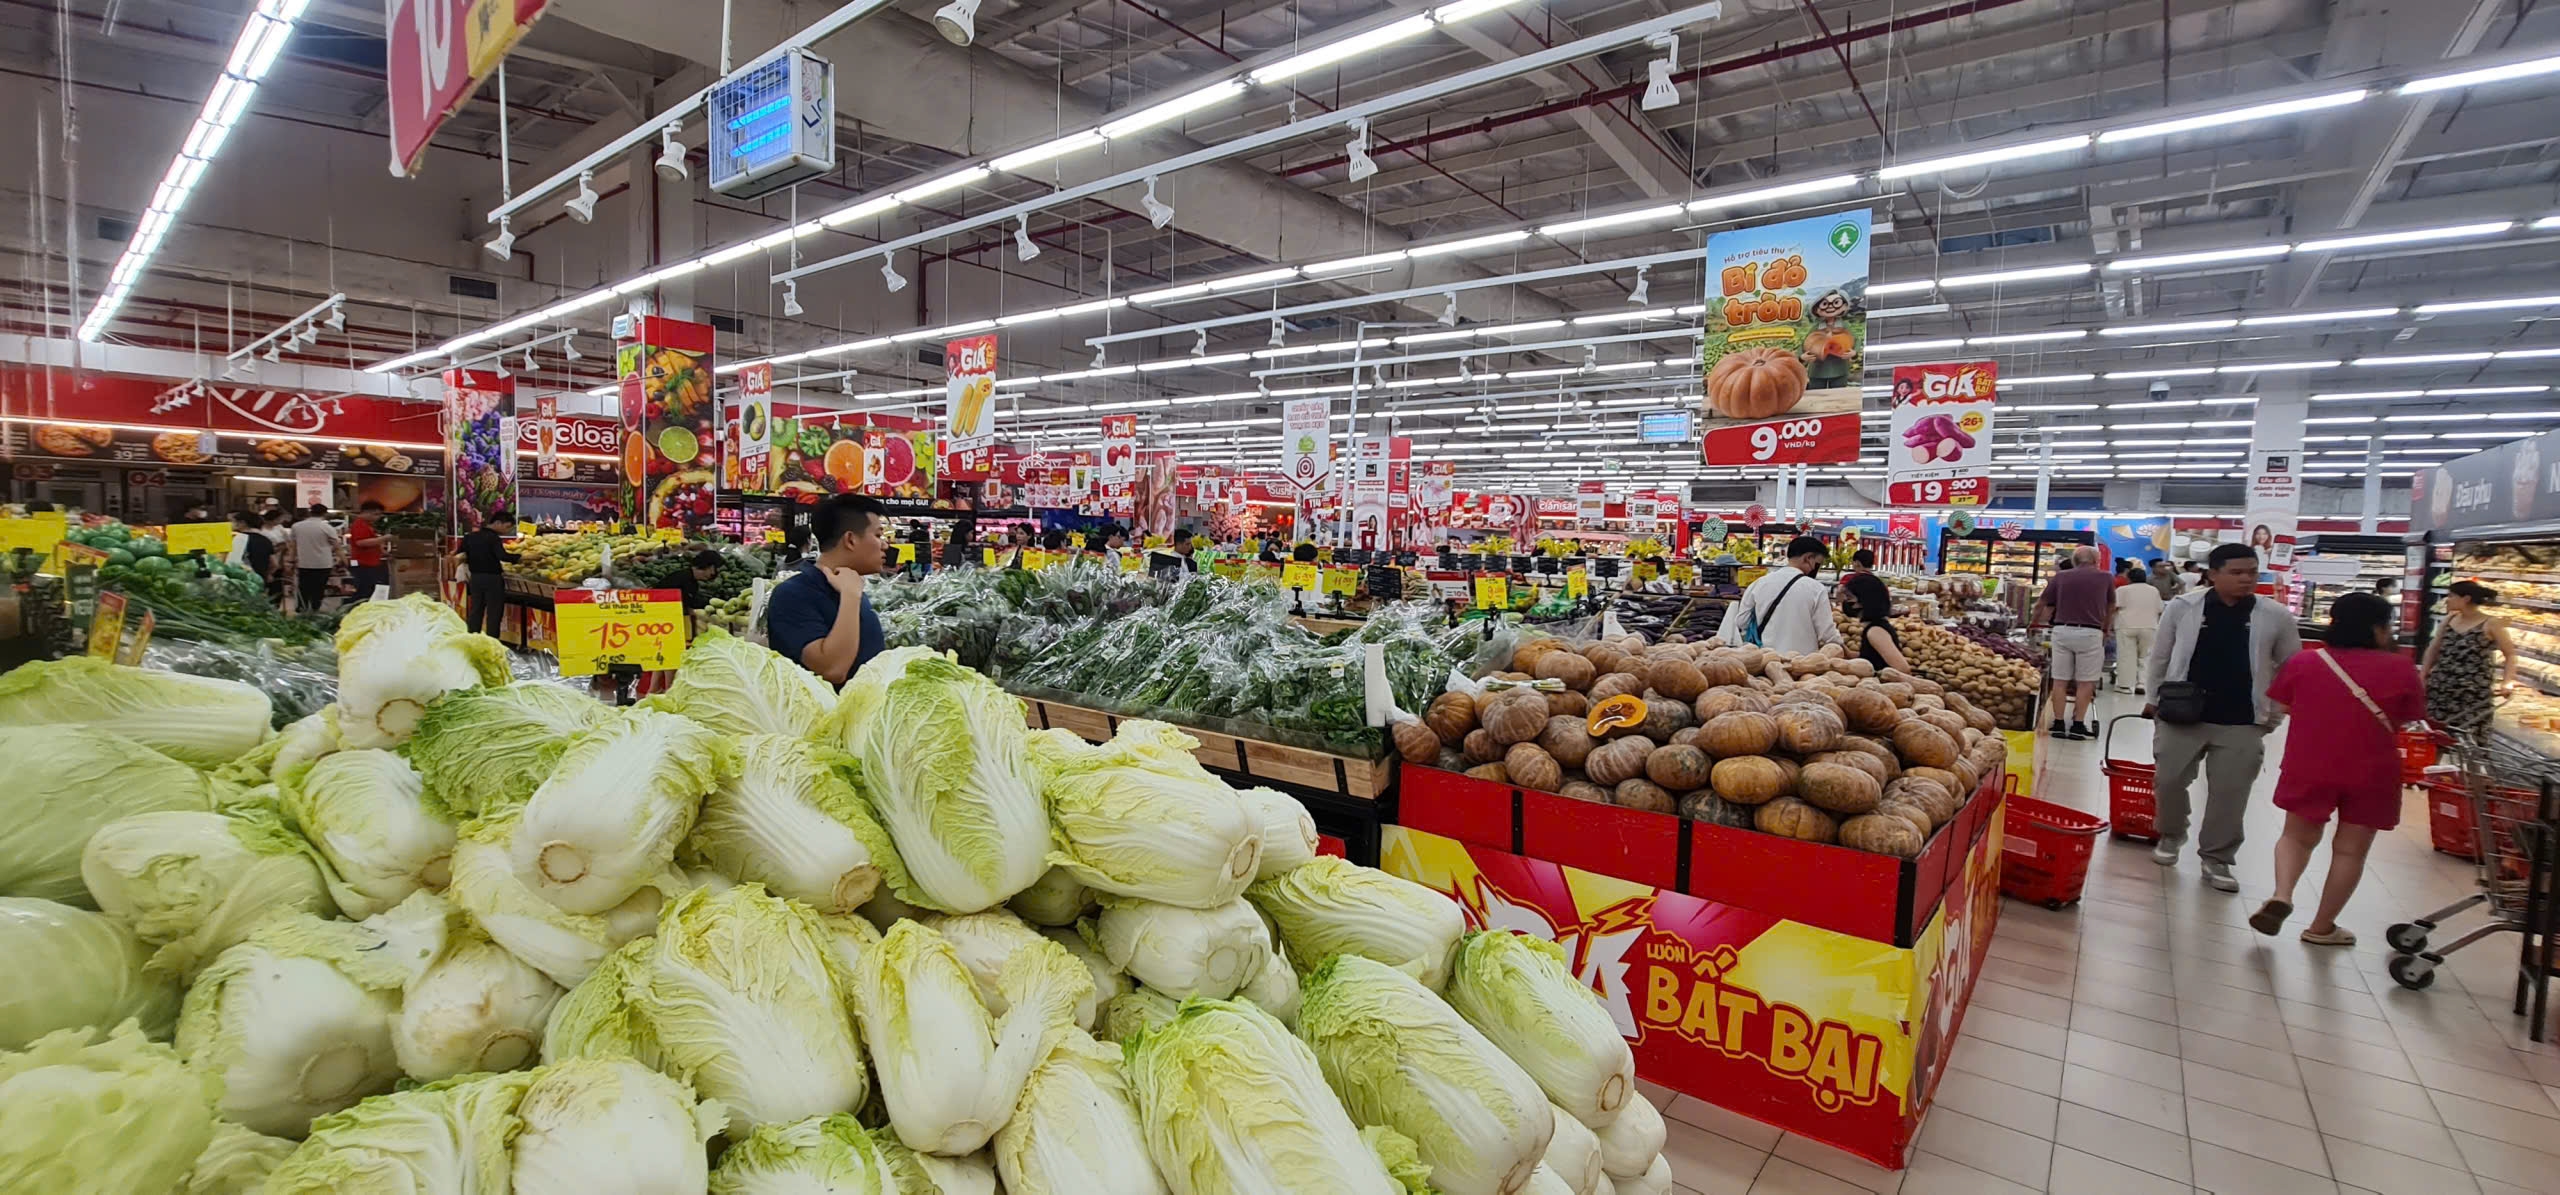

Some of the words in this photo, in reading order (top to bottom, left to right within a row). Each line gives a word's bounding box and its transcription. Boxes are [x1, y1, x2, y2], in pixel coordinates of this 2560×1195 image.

[1722, 262, 1758, 297] Bí
[1761, 254, 1807, 291] đỏ
[1722, 292, 1802, 327] tròn
[961, 342, 988, 371] GIÁ
[747, 368, 765, 391] GIÁ
[1923, 368, 1978, 399] GIÁ
[1111, 419, 1130, 436] GIÁ
[1784, 440, 1816, 449] VND/kg
[1270, 482, 1292, 497] Sushi
[901, 498, 914, 507] mọi
[1657, 501, 1678, 512] ước
[596, 590, 620, 604] GIÁ
[590, 622, 633, 650] 15
[1646, 939, 1686, 963] LUÔN
[1645, 951, 1759, 1052] BẤT
[1770, 1007, 1878, 1104] BẠI
